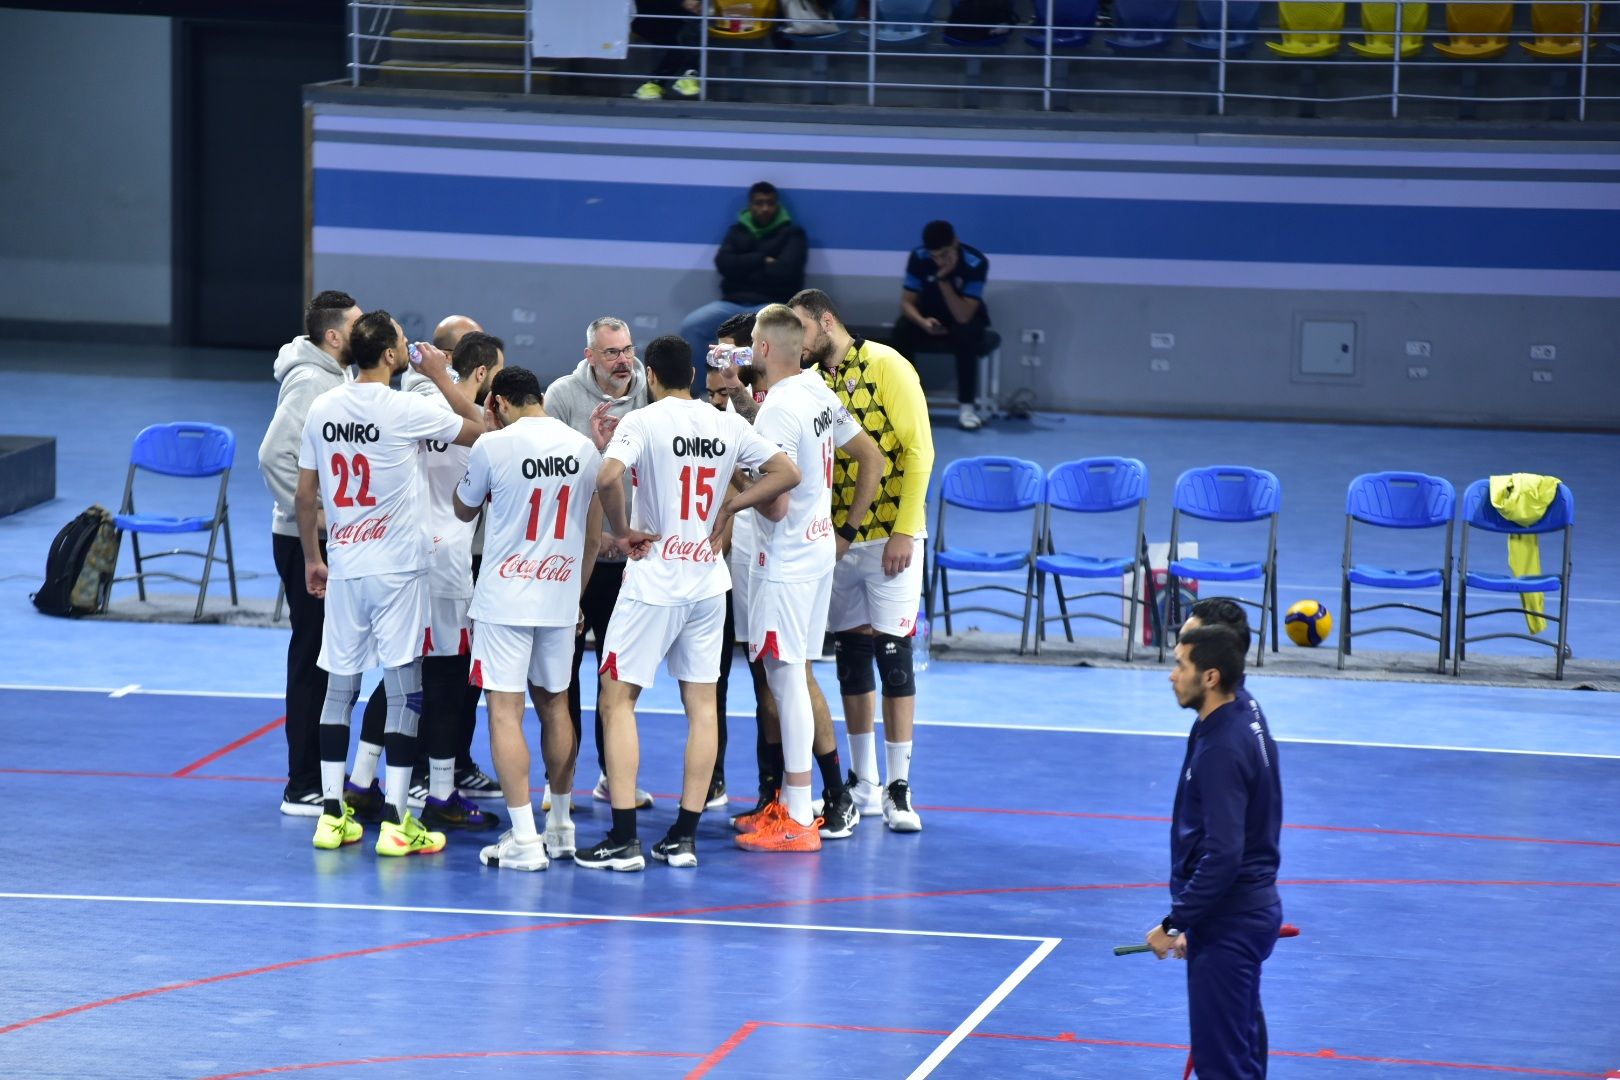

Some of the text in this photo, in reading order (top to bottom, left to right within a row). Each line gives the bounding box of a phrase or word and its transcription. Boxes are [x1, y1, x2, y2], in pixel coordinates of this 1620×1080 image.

[323, 422, 381, 445] ONIRO
[813, 406, 834, 438] ONIRO
[672, 435, 727, 459] ONIRO
[331, 453, 377, 508] 22
[521, 455, 580, 481] ONIRO
[679, 465, 717, 522] 15
[525, 485, 572, 541] 11
[329, 514, 393, 546] Cca-Cola
